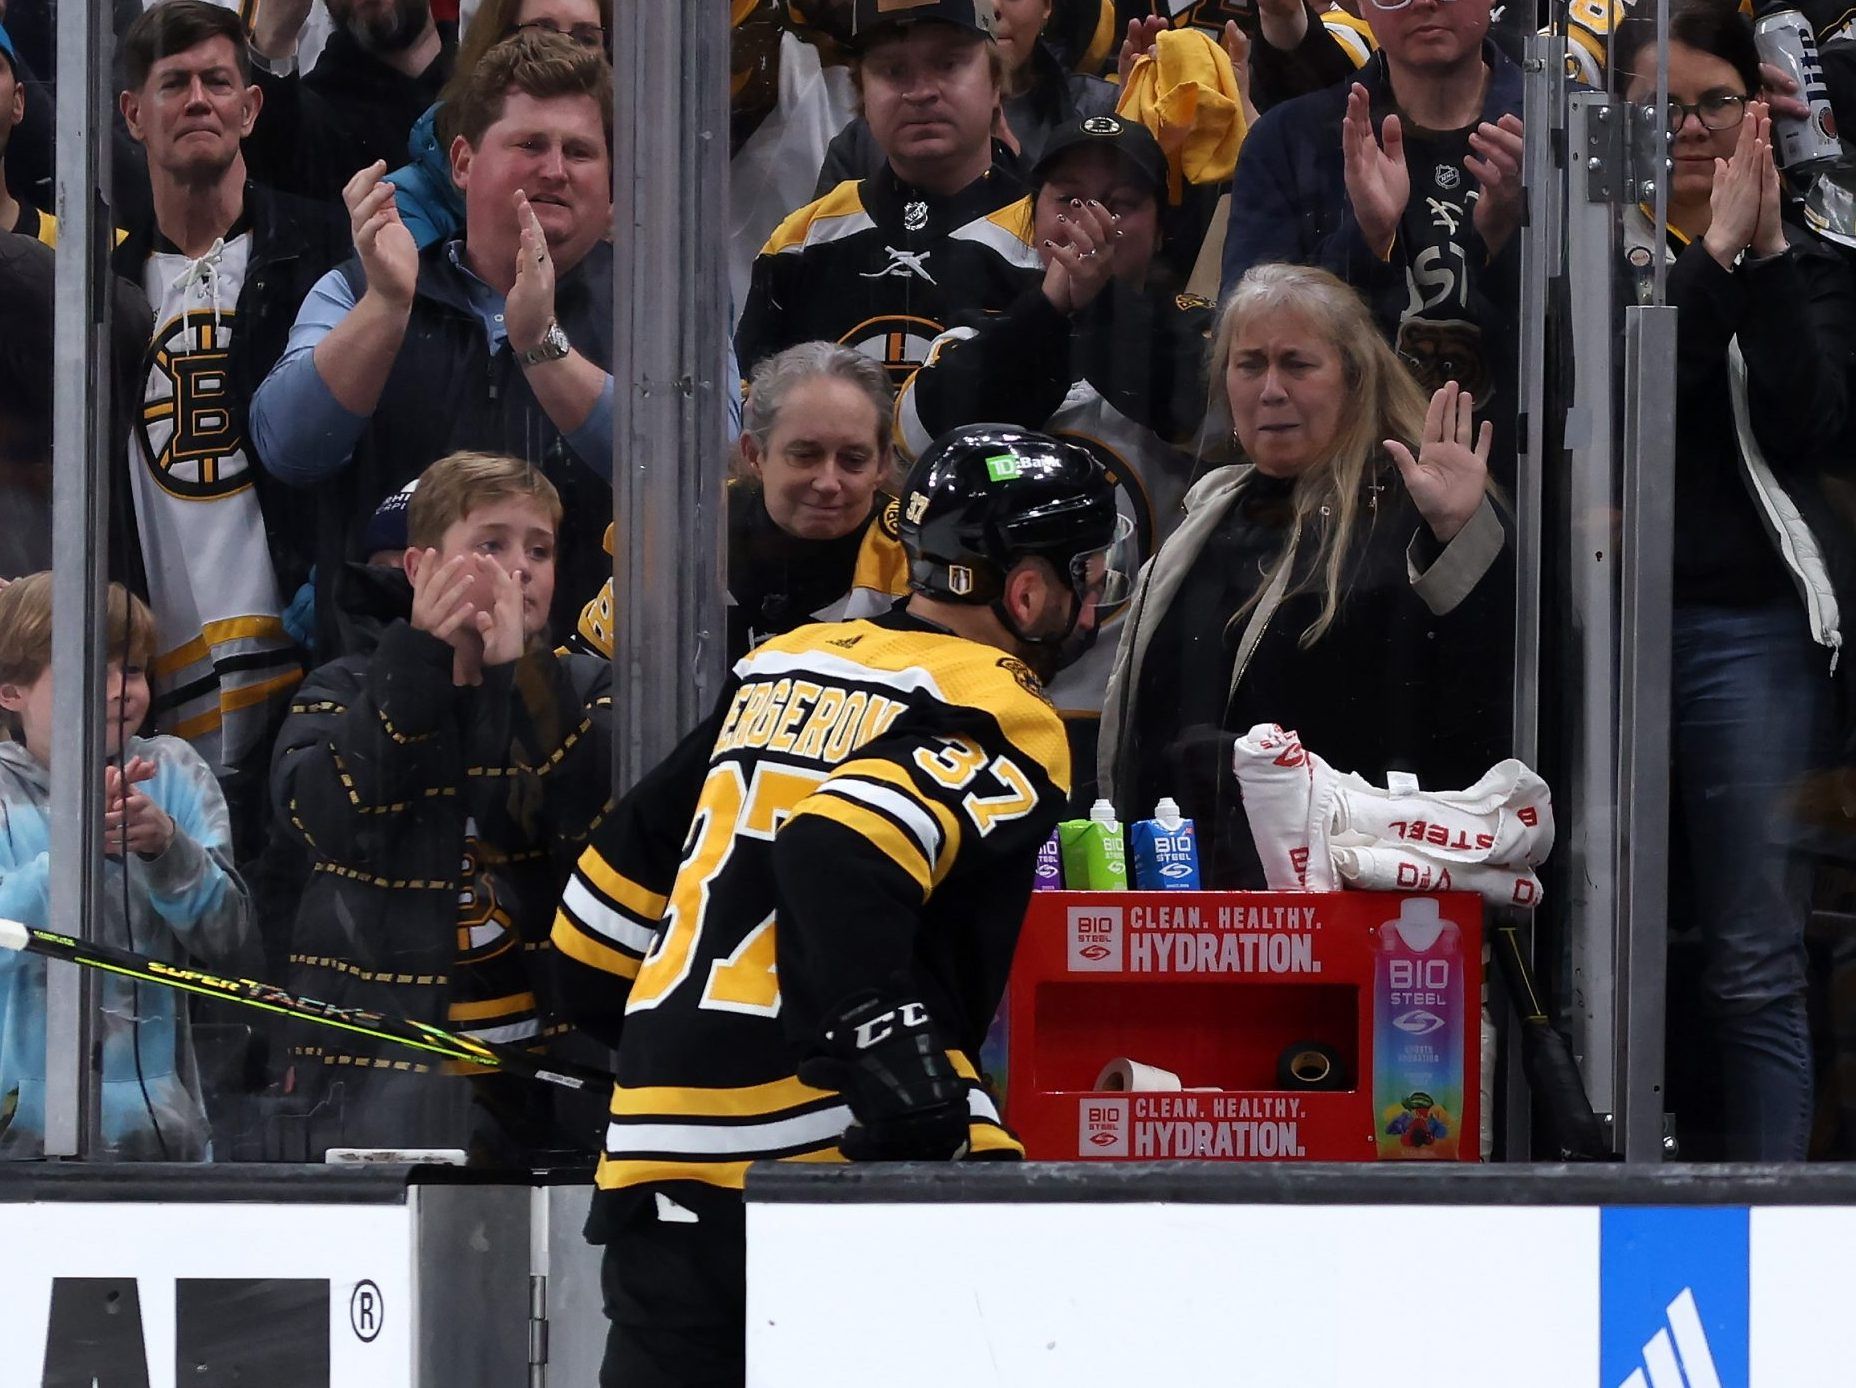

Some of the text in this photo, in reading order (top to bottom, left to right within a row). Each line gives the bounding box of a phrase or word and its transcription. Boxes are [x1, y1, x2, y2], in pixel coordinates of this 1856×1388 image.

[1019, 455, 1063, 471] Bank
[905, 490, 931, 526] 37
[709, 677, 909, 764] ERGERON
[912, 734, 1041, 839] 37
[1103, 837, 1125, 851] BIO
[1387, 818, 1496, 851] STEEL
[1153, 836, 1192, 854] BIO
[1037, 855, 1058, 863] TEEL
[1155, 852, 1192, 862] STEEL
[1078, 917, 1112, 933] BIO
[1130, 906, 1322, 930] CLEAN. HEALTHY.
[1078, 934, 1112, 943] STEEL
[1129, 932, 1322, 974] HYDRATION.
[147, 962, 241, 991] SUPER
[1388, 959, 1449, 989] BIO
[1389, 992, 1447, 1005] STEEL
[1089, 1108, 1120, 1122] BIO
[1135, 1098, 1306, 1118] CLEAN. HEALTHY.
[1089, 1123, 1119, 1131] STEEL
[1134, 1121, 1306, 1157] HYDRATION.
